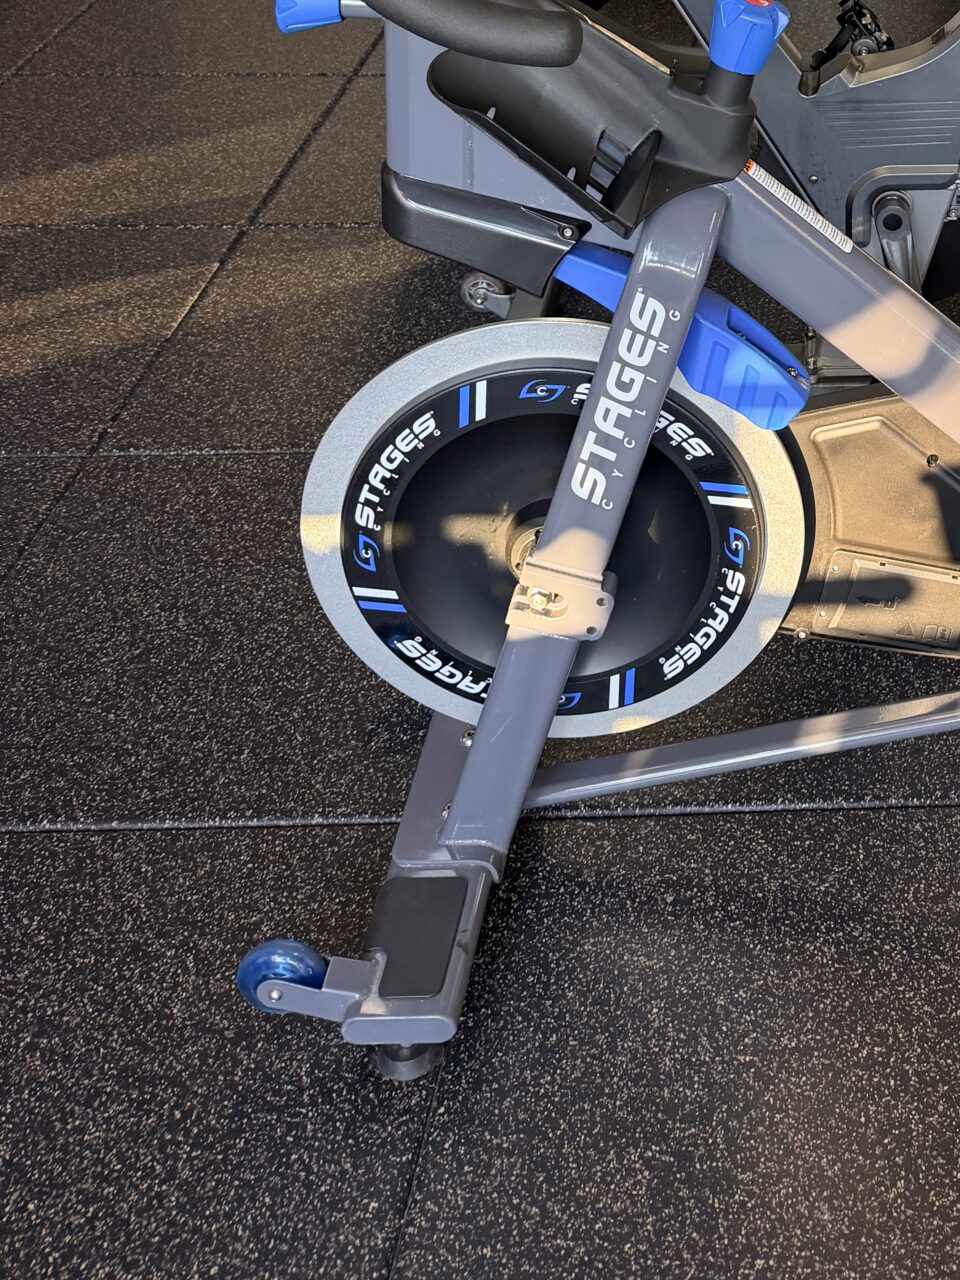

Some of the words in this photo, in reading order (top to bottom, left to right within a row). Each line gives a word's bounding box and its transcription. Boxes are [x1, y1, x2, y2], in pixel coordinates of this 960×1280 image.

[571, 291, 666, 506] STAGES
[601, 309, 681, 511] CYCLING
[354, 410, 437, 529] STAGES
[373, 428, 442, 532] CYCLING
[662, 569, 746, 680] STAGES
